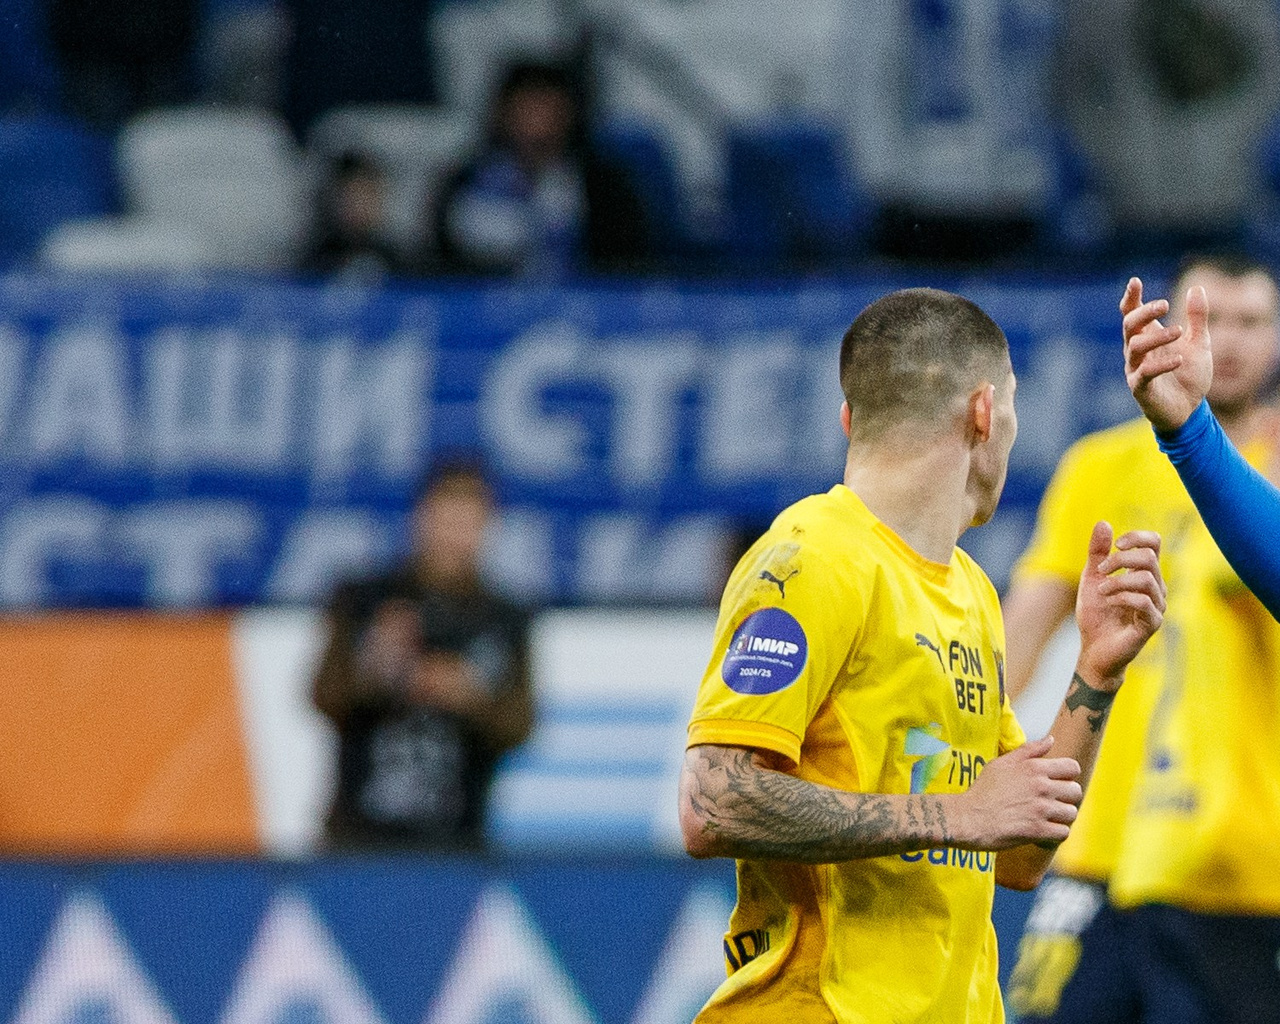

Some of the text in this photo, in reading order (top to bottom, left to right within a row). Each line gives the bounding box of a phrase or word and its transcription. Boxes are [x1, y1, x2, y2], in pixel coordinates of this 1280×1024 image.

[752, 637, 799, 656] МИР
[949, 640, 983, 679] FON
[955, 677, 987, 715] BET
